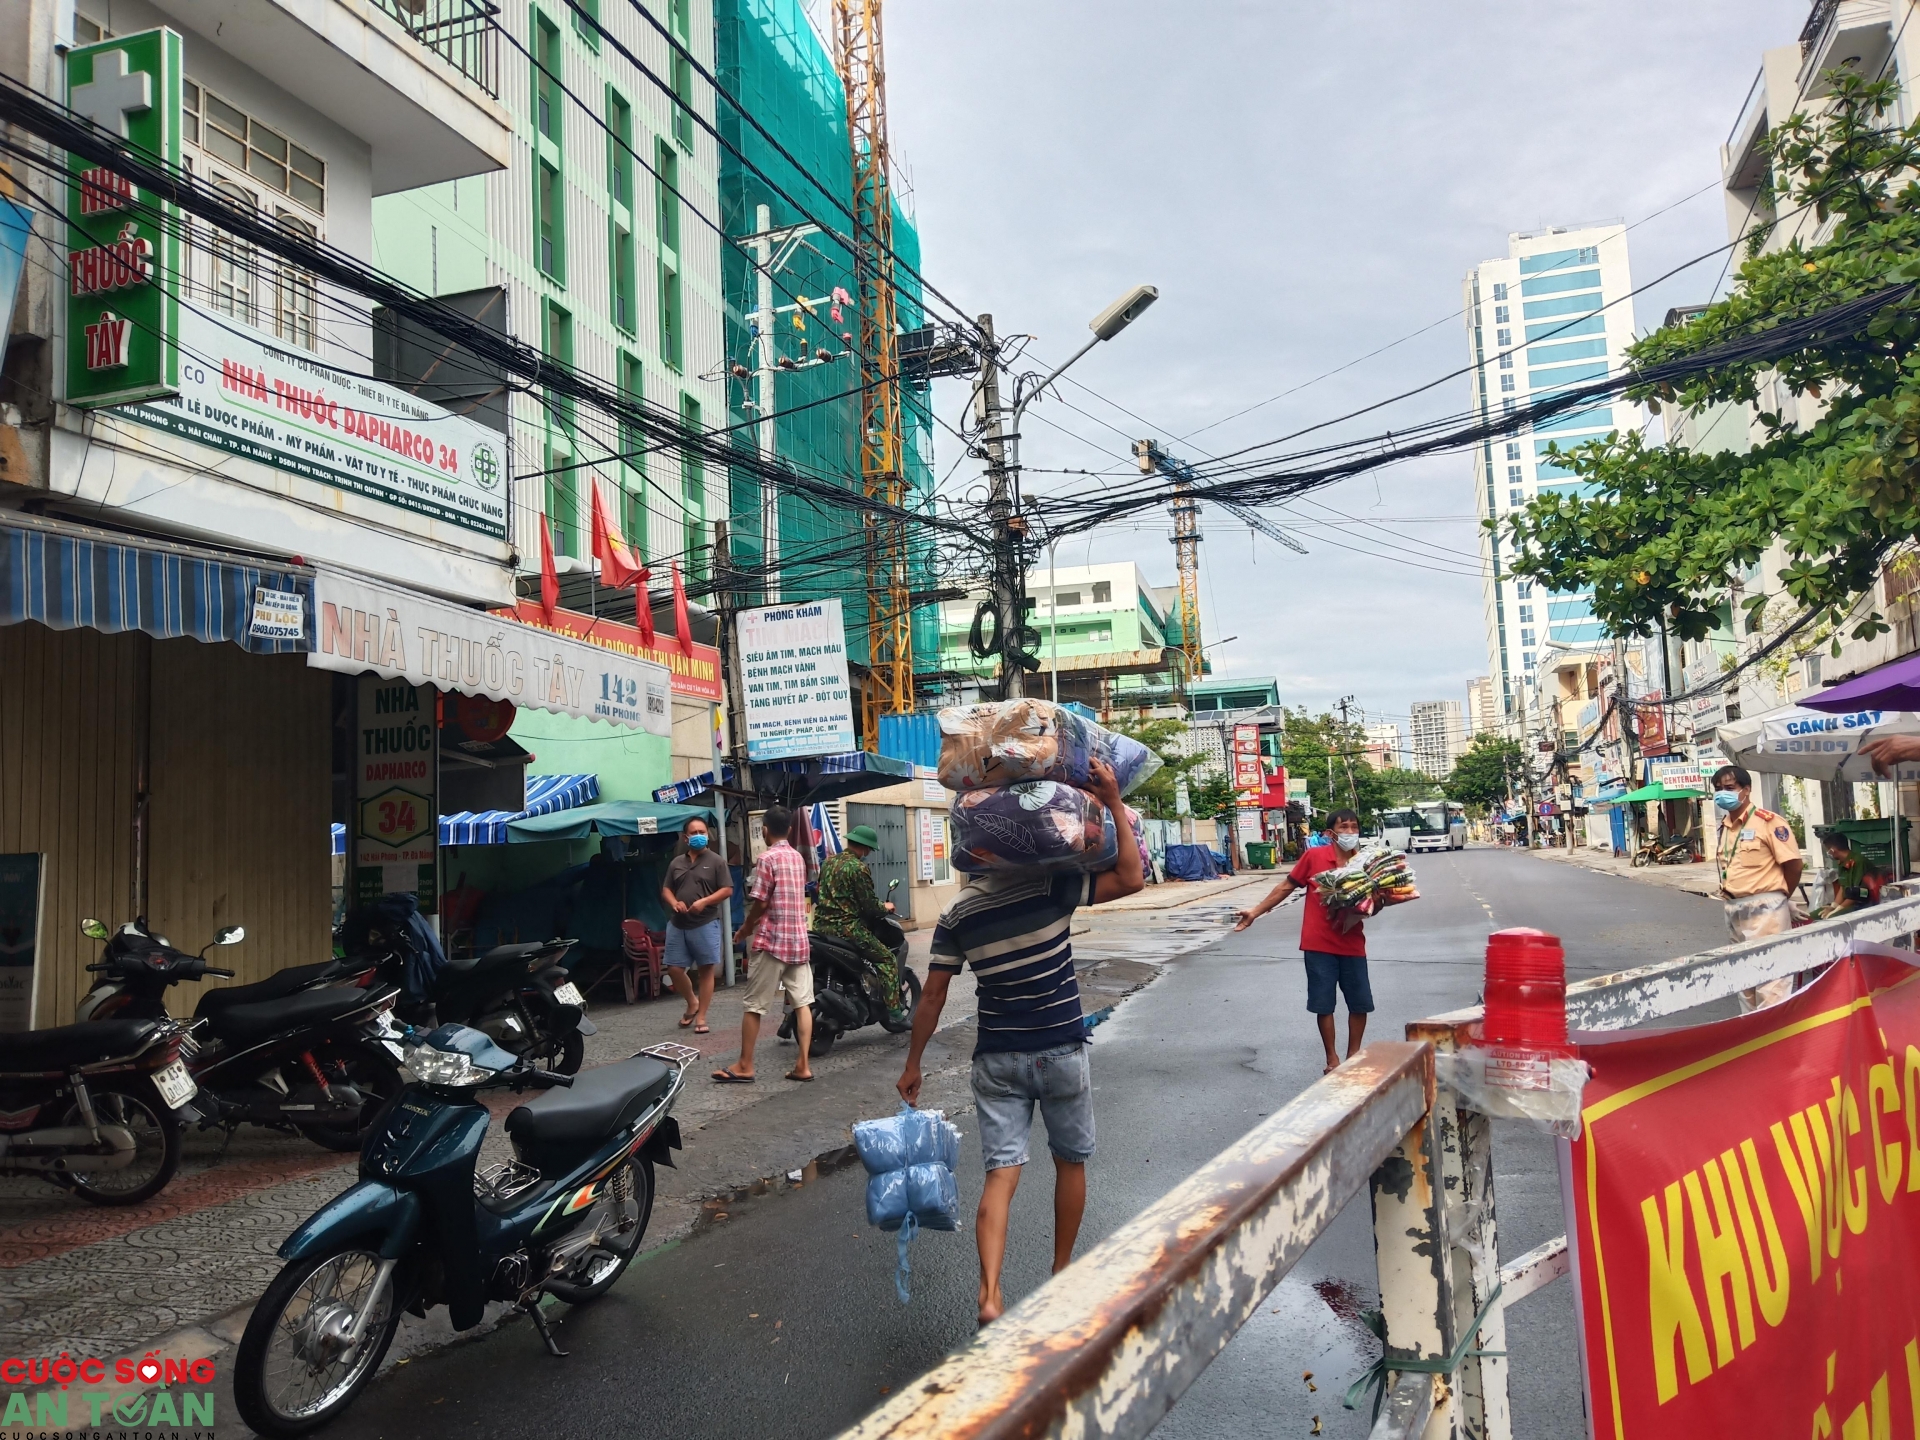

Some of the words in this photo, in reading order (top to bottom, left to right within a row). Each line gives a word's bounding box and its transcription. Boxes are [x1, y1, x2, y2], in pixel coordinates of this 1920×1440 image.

[68, 222, 153, 297] THUỐC
[84, 311, 132, 370] TÂY
[287, 353, 297, 366] TY
[332, 373, 352, 390] DƯỢC
[377, 392, 385, 406] BỊ
[385, 394, 392, 406] Y
[222, 358, 268, 404] NHÀ
[274, 378, 338, 429] THUỐC
[344, 406, 434, 465] DAPHARCO
[439, 444, 458, 474] 34
[140, 409, 168, 426] PHÒNG
[178, 423, 186, 432] Q.
[203, 431, 223, 445] CHÂU
[229, 440, 239, 450] TP.
[389, 493, 397, 501] GP
[460, 516, 470, 525] TEL:
[205, 405, 238, 428] DƯỢC
[345, 454, 363, 472] VẬT
[380, 467, 386, 479] Y
[388, 468, 398, 483] TẾ
[407, 476, 429, 494] THỰC
[458, 493, 479, 511] CHỨC
[481, 502, 503, 519] NĂNG
[764, 609, 794, 622] PHÒNG
[796, 604, 822, 618] KHÁM
[252, 624, 299, 636] 0903.075745
[746, 626, 778, 648] TIM
[322, 600, 406, 671] NHÀ
[417, 632, 524, 696] THUỐC
[534, 654, 585, 709] TÂY
[746, 651, 764, 663] SIÊU
[766, 649, 778, 661] ÂM
[780, 649, 797, 658] TIM,
[799, 646, 821, 658] MẠCH
[824, 642, 841, 654] MÁU
[670, 652, 689, 676] VĂN
[691, 661, 715, 682] MINH
[747, 666, 768, 680] BỆNH
[770, 664, 793, 677] MẠCH
[795, 661, 816, 673] VÀNH
[598, 672, 638, 706] 142
[749, 682, 763, 693] VAN
[766, 681, 782, 692] TIM,
[784, 679, 798, 689] TIM
[820, 675, 839, 686] SINH
[750, 696, 770, 709] TĂNG
[772, 692, 796, 706] HUYẾT
[798, 692, 808, 703] ÁP
[816, 690, 830, 703] ĐỘT
[594, 702, 610, 716] HẢI
[612, 705, 641, 723] PHÒNG
[749, 722, 760, 730] TIM
[784, 718, 801, 727] BỆNH
[803, 716, 818, 726] VIỆN
[362, 716, 431, 755] THUỐC
[769, 728, 795, 737] NGHIỆP:
[1787, 717, 1838, 736] CẢNH
[366, 760, 427, 781] DAPHARCO
[1664, 775, 1702, 785] CENTERLAB
[378, 800, 416, 835] 34
[402, 1103, 431, 1116] HONDA
[1640, 1138, 1790, 1406] KHU
[1770, 1075, 1869, 1296] VỰC
